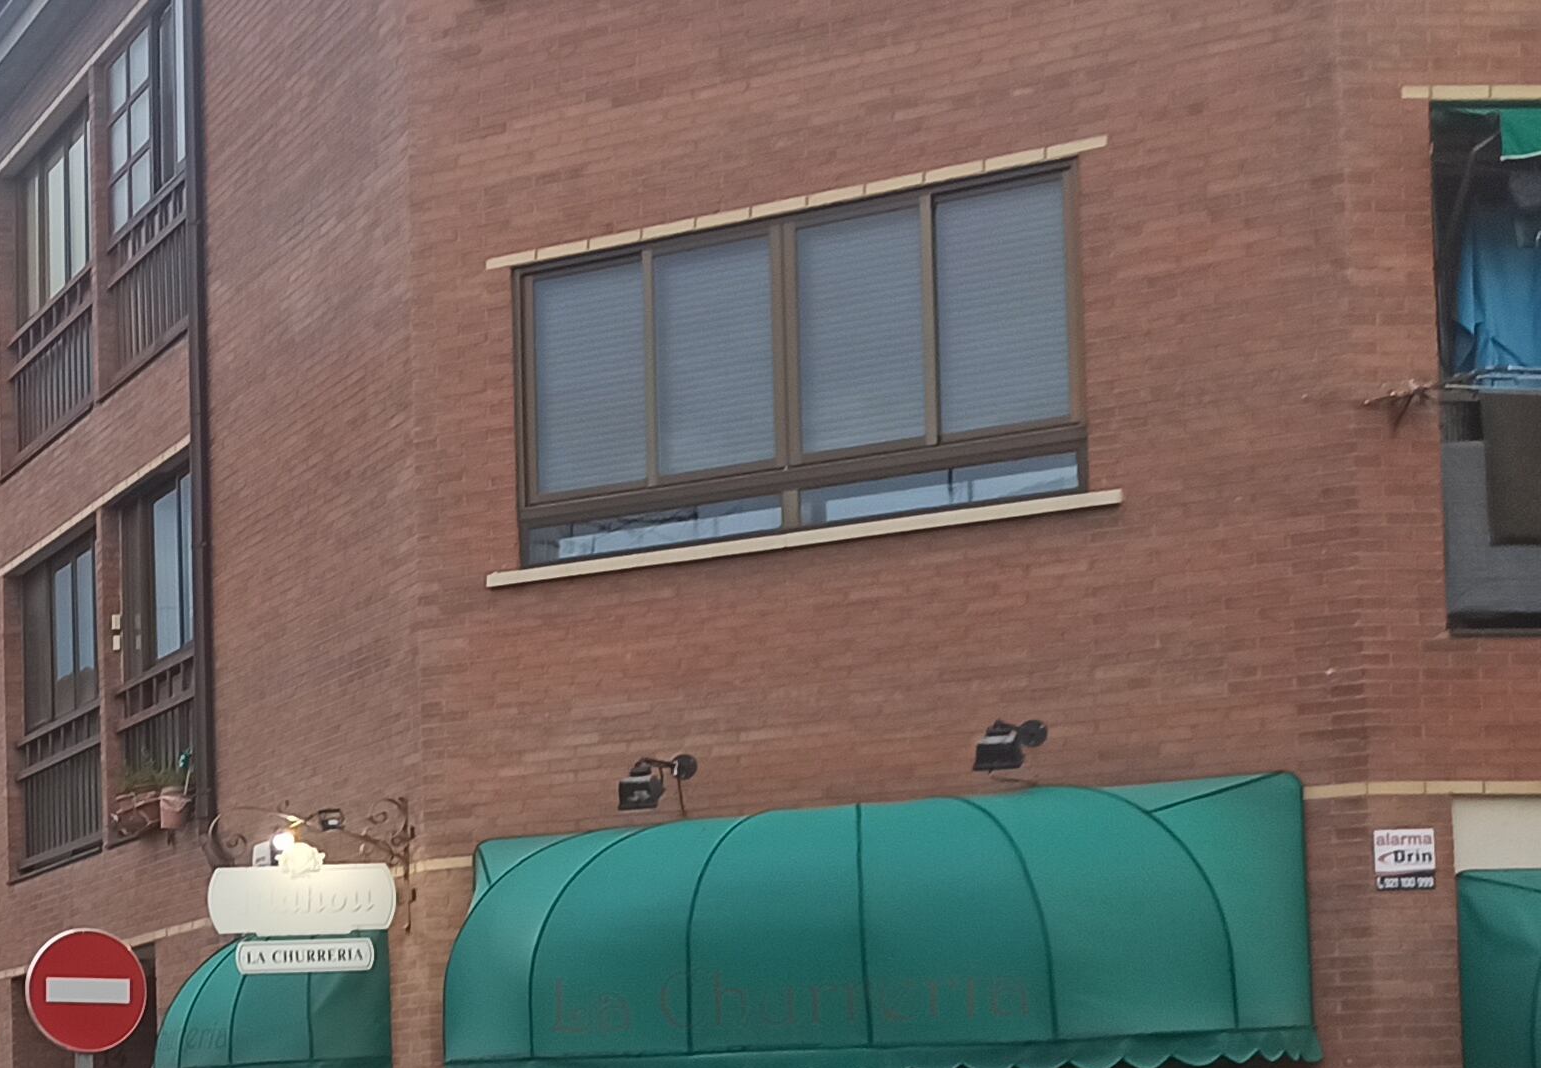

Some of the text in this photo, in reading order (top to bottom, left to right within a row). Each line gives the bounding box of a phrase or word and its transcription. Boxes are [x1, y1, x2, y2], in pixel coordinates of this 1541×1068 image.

[1376, 832, 1432, 846] alarma
[246, 948, 364, 965] LA CHURRERIA
[551, 977, 632, 1035] La
